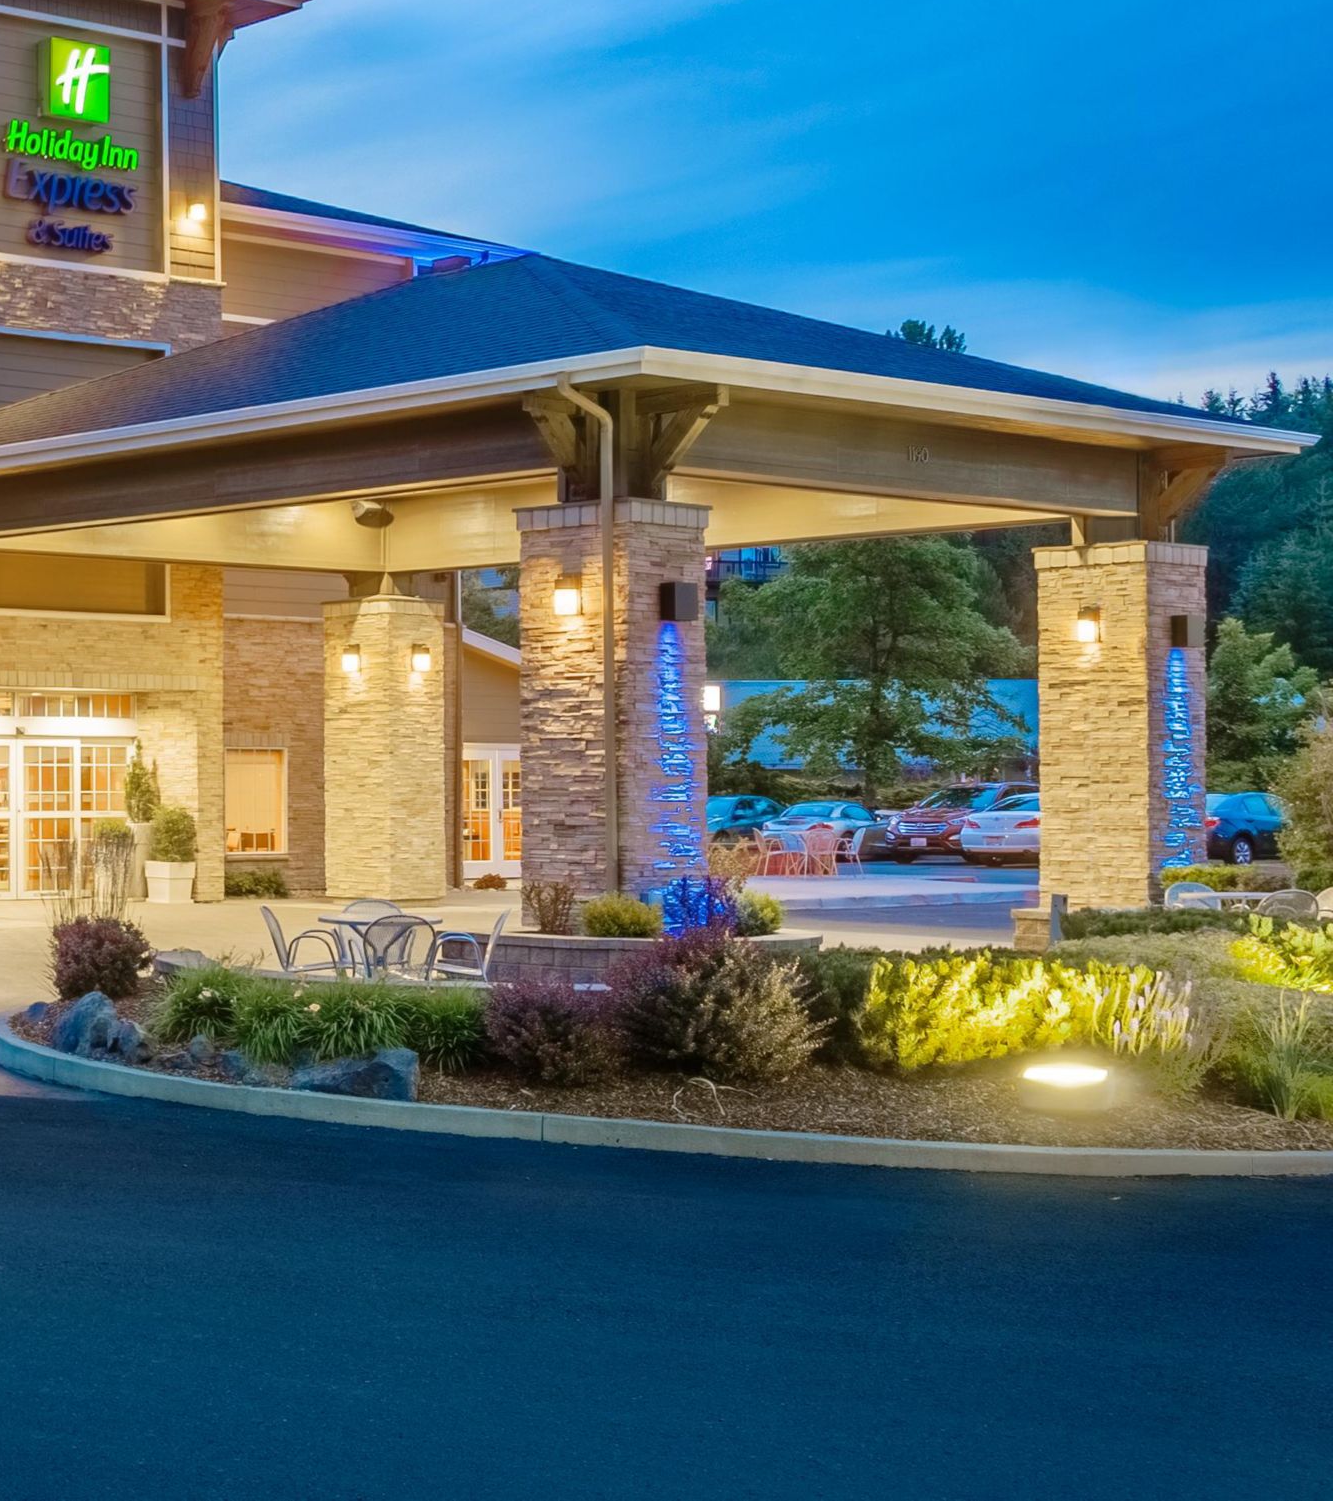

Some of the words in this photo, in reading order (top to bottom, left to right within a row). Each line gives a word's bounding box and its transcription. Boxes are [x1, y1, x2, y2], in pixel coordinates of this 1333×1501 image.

[7, 119, 98, 171] Holiday
[102, 135, 138, 171] Inn
[7, 159, 137, 213] Express
[28, 219, 49, 244] &
[50, 218, 113, 251] Suites
